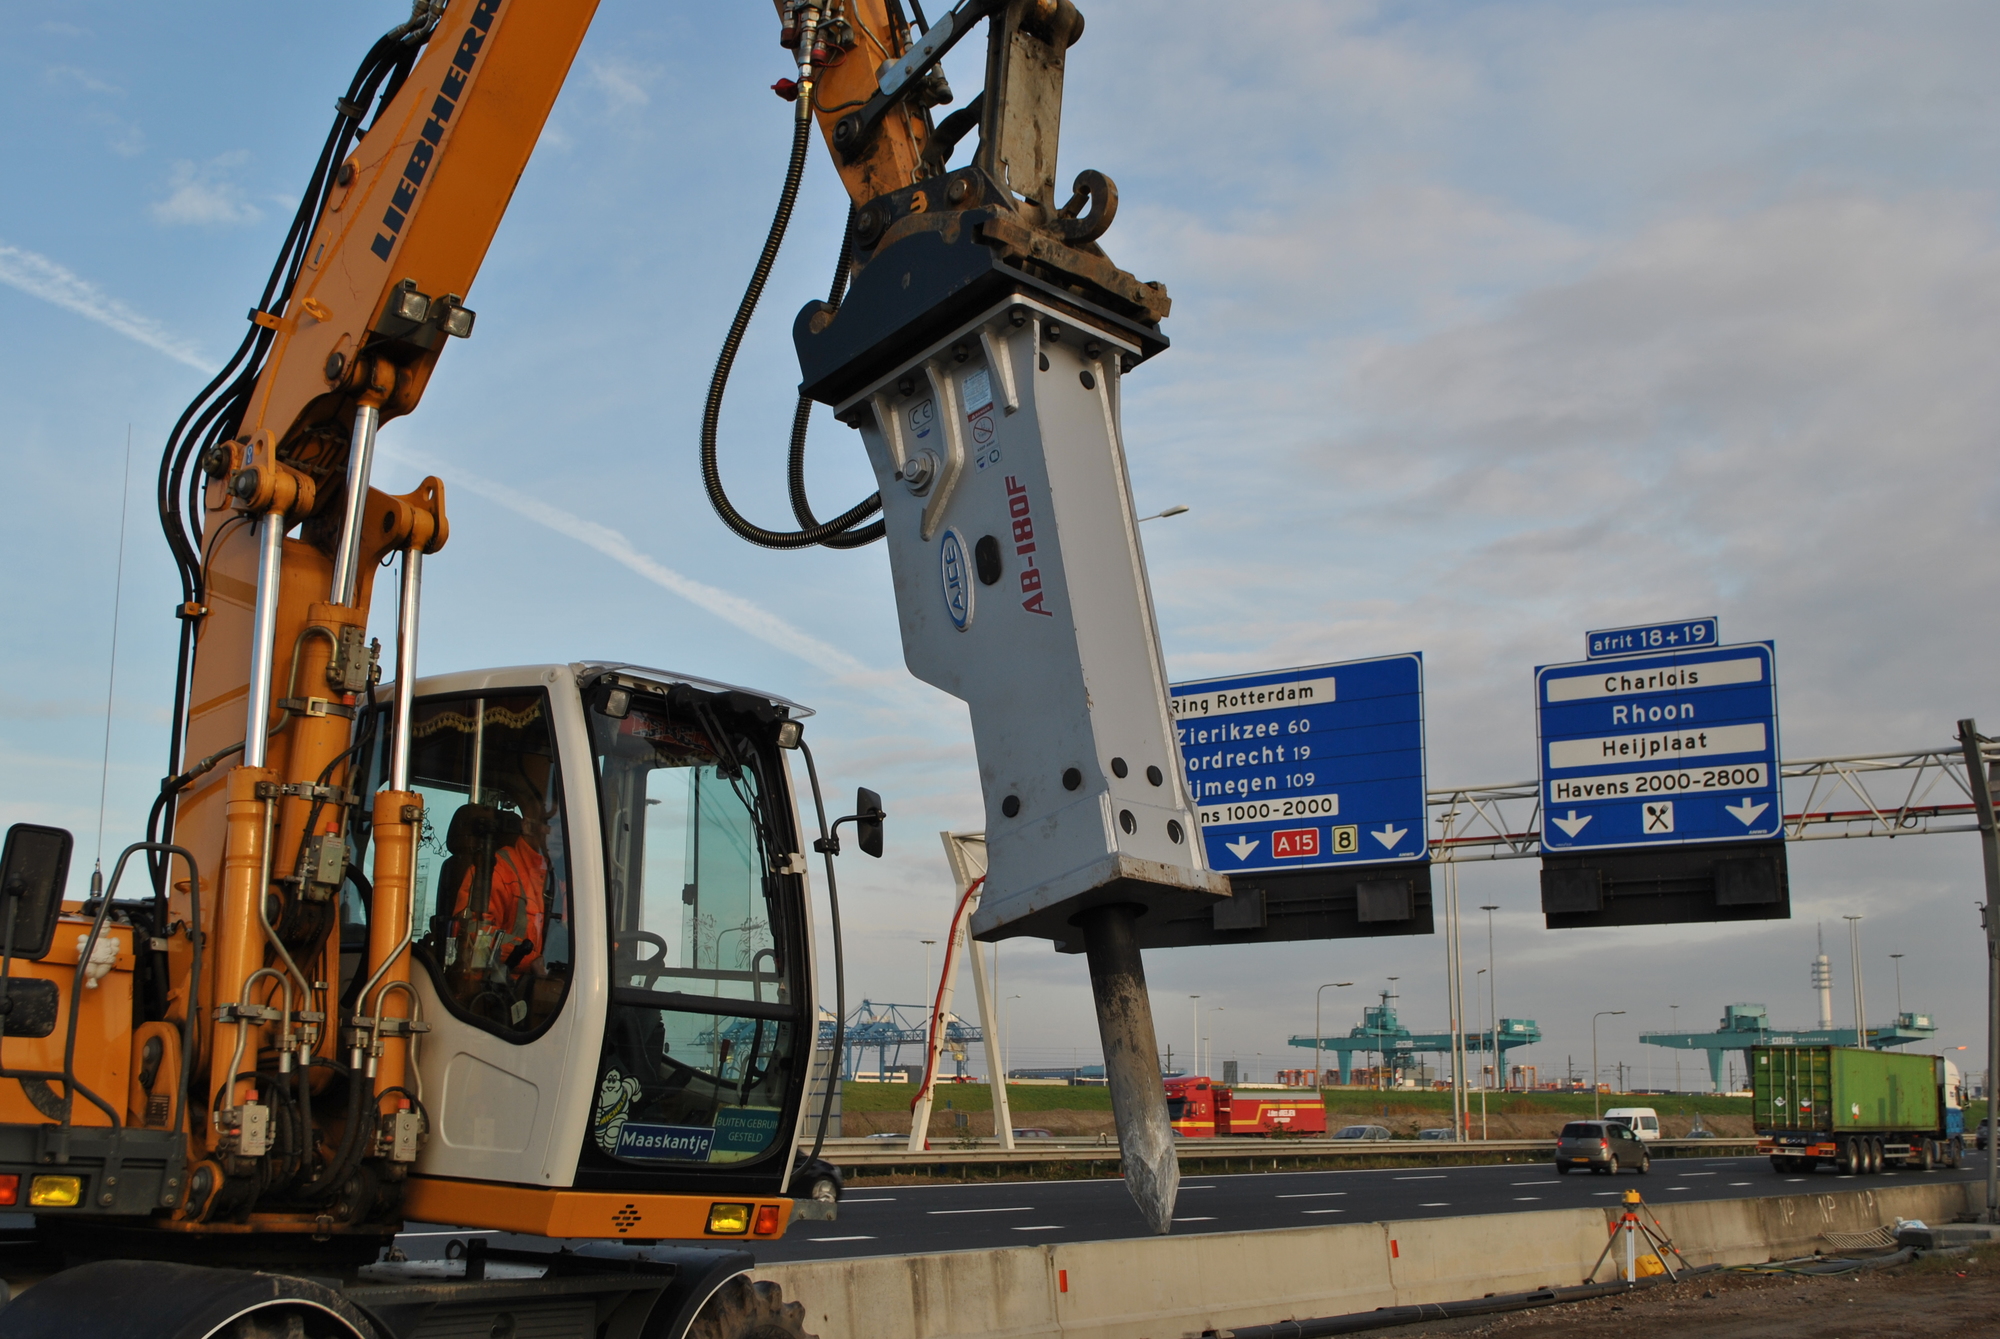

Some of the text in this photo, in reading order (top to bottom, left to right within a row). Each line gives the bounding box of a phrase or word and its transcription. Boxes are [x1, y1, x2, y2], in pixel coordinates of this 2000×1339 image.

[370, 0, 501, 263] LIEBHERR
[1004, 475, 1053, 618] AB-180F
[945, 543, 965, 611] AJCE
[1593, 634, 1633, 652] afrit
[1604, 669, 1699, 693] Charlois
[1171, 684, 1314, 715] Ring Rotterdam
[1612, 702, 1695, 726] Rhoon
[1177, 718, 1311, 747] Zierikzee 60
[1602, 732, 1708, 759] Heijplaat
[1182, 744, 1311, 771] ordrecht 19
[1187, 772, 1316, 804] ijmegen 109
[1556, 767, 1760, 800] Havens 2000-2800
[1226, 797, 1333, 822] 1000-2000
[1338, 830, 1352, 849] 8
[1320, 1040, 1326, 1048] 4
[716, 1116, 746, 1128] BUITEN
[621, 1130, 709, 1155] Maaskantje
[728, 1131, 763, 1143] GESTELD
[1818, 1195, 1836, 1224] NP
